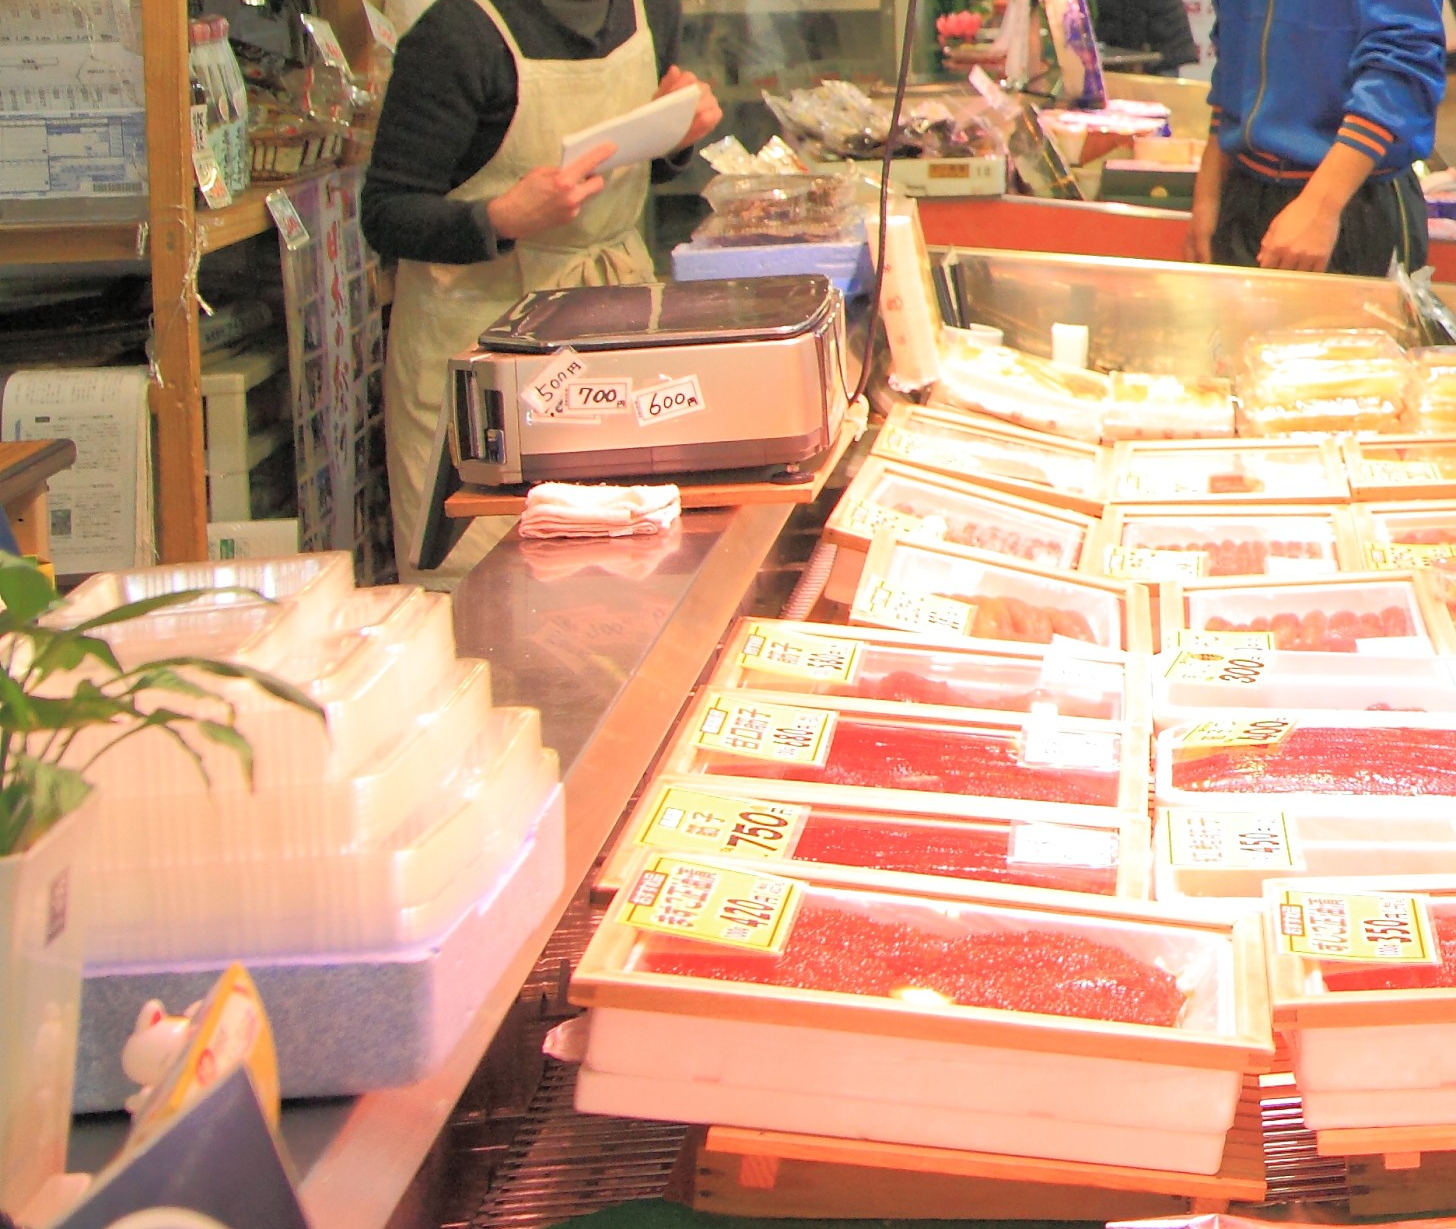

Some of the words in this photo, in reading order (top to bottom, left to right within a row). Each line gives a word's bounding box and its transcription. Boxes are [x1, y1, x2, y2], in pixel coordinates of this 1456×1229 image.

[535, 360, 582, 404] 500円
[578, 386, 628, 409] 700円
[648, 391, 699, 417] 600円
